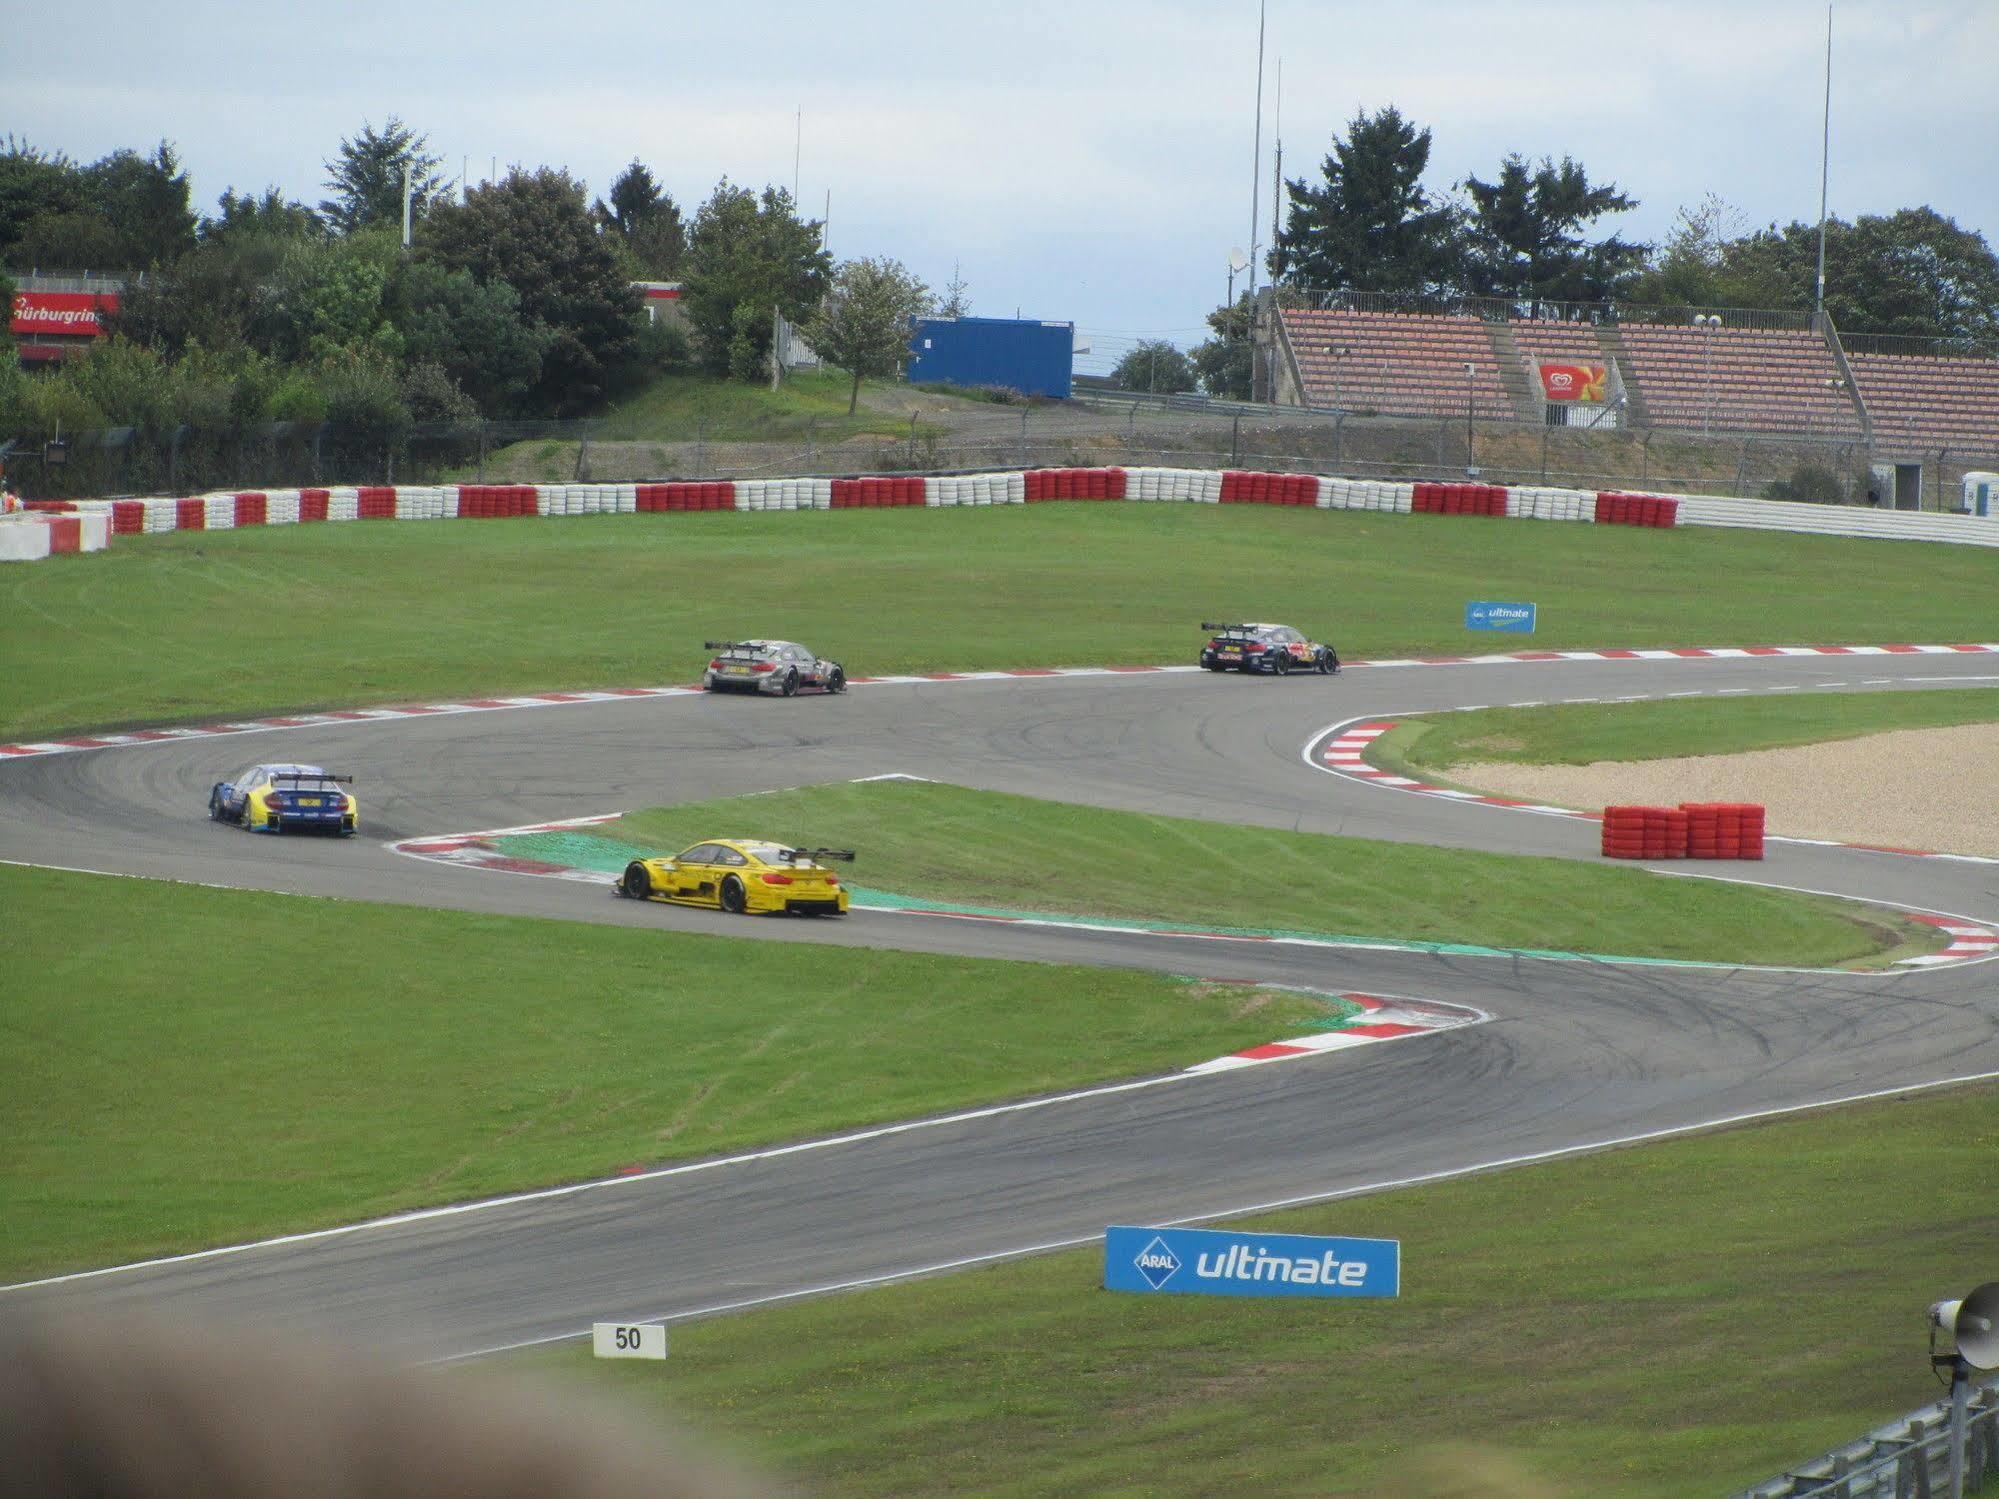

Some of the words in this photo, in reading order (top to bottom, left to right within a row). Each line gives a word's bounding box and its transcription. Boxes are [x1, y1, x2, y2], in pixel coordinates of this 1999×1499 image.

[1489, 607, 1529, 618] ultimate
[1141, 1254, 1175, 1269] ARAL
[1196, 1245, 1368, 1287] ultimate
[616, 1327, 641, 1350] 50
